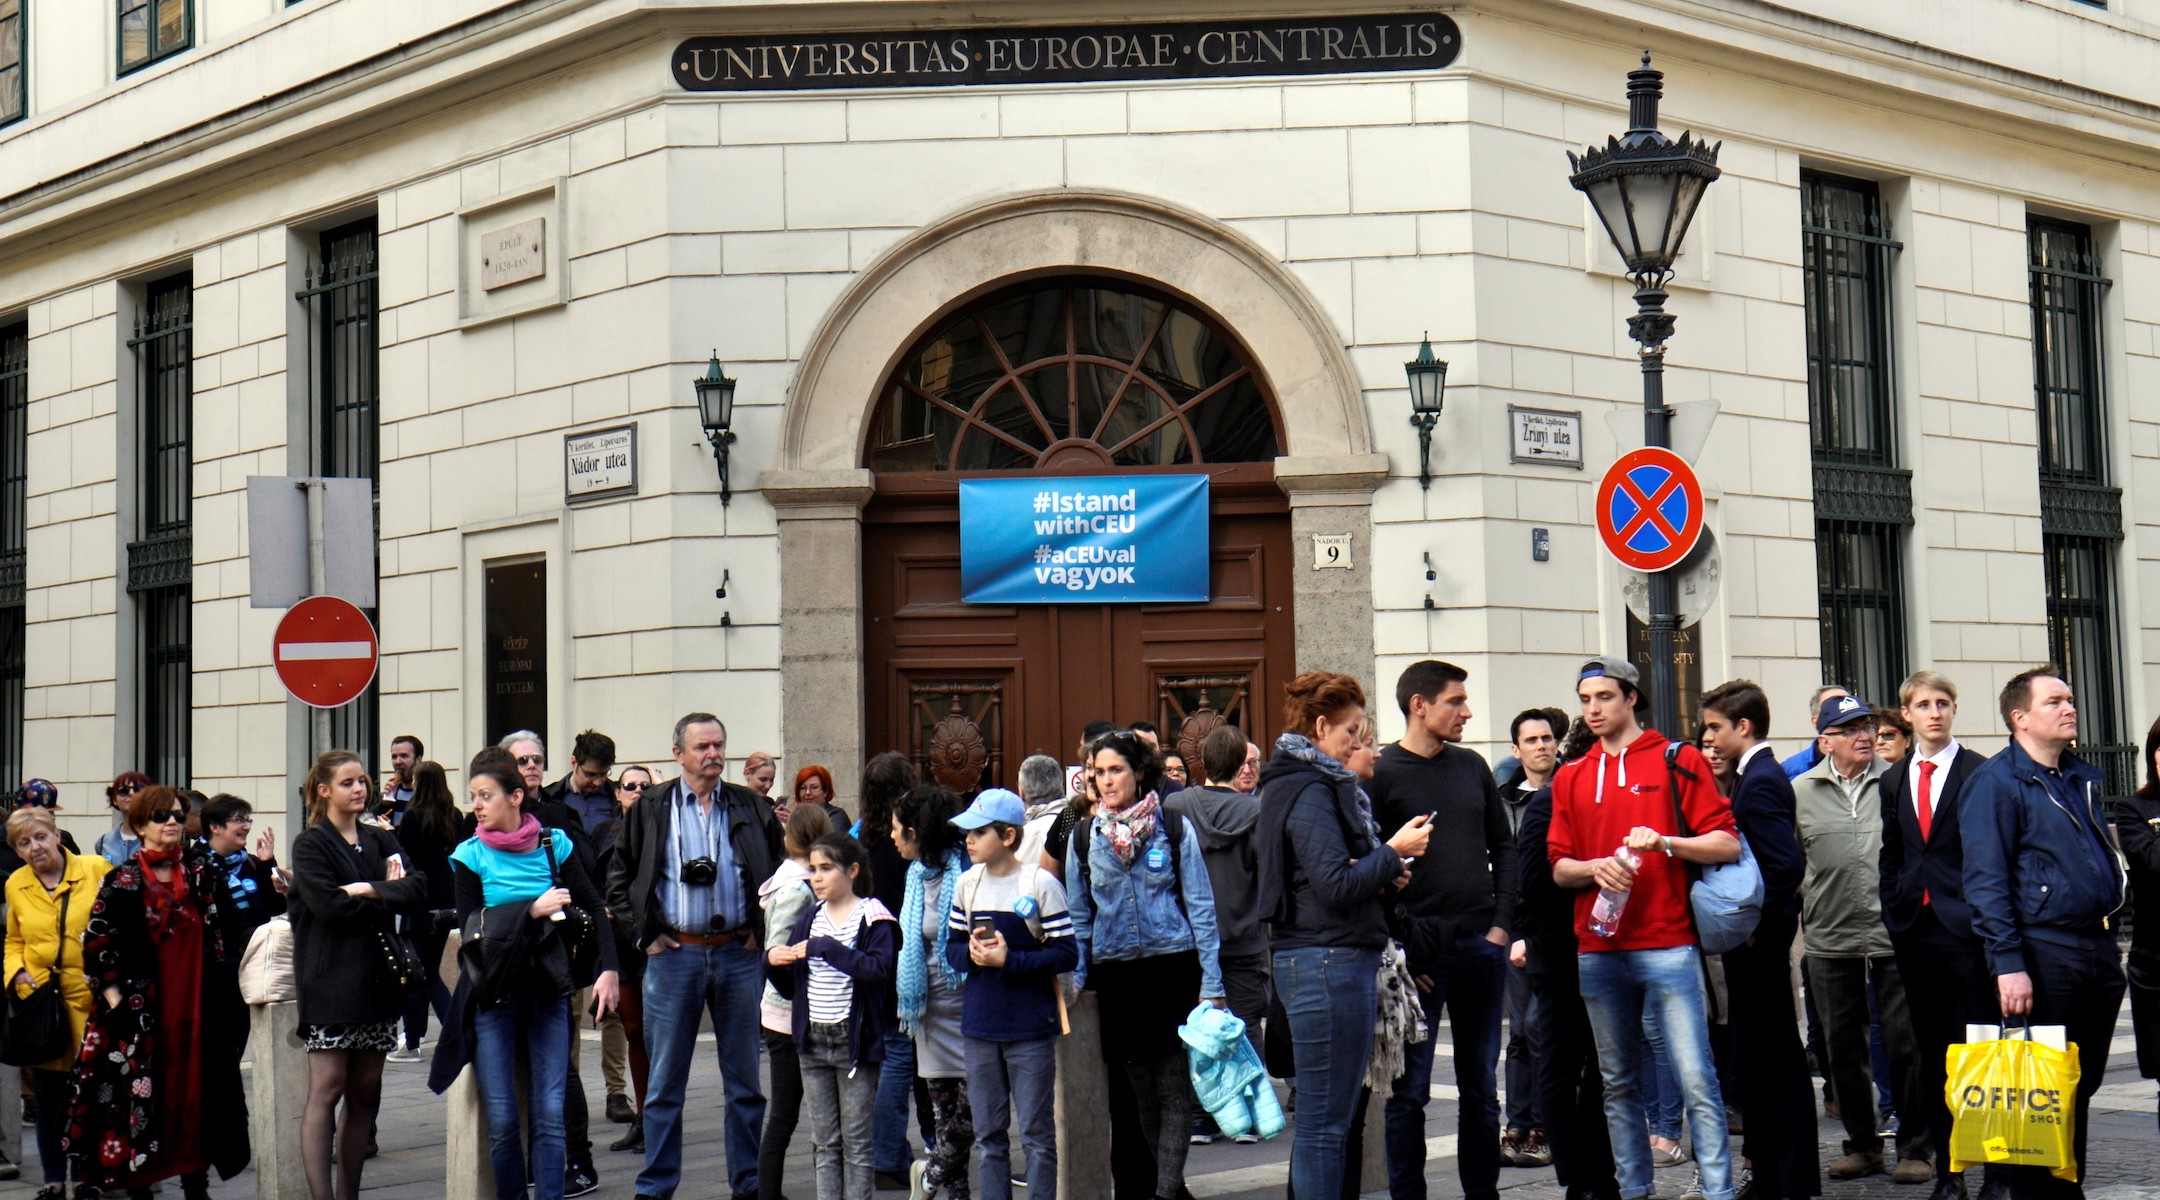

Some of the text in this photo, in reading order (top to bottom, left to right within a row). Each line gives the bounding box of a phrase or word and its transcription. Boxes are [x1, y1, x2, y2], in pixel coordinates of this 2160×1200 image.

[690, 23, 1438, 82] UNIVERSITAS EUROPAE CENTRALIS
[1553, 428, 1570, 445] utca
[571, 452, 627, 476] Nádor utca
[1033, 489, 1135, 513] #Istand
[1034, 515, 1135, 535] withCEU
[1034, 544, 1135, 564] #aCEUval
[1328, 546, 1339, 564] 9
[1963, 1085, 2060, 1112] OFFICE
